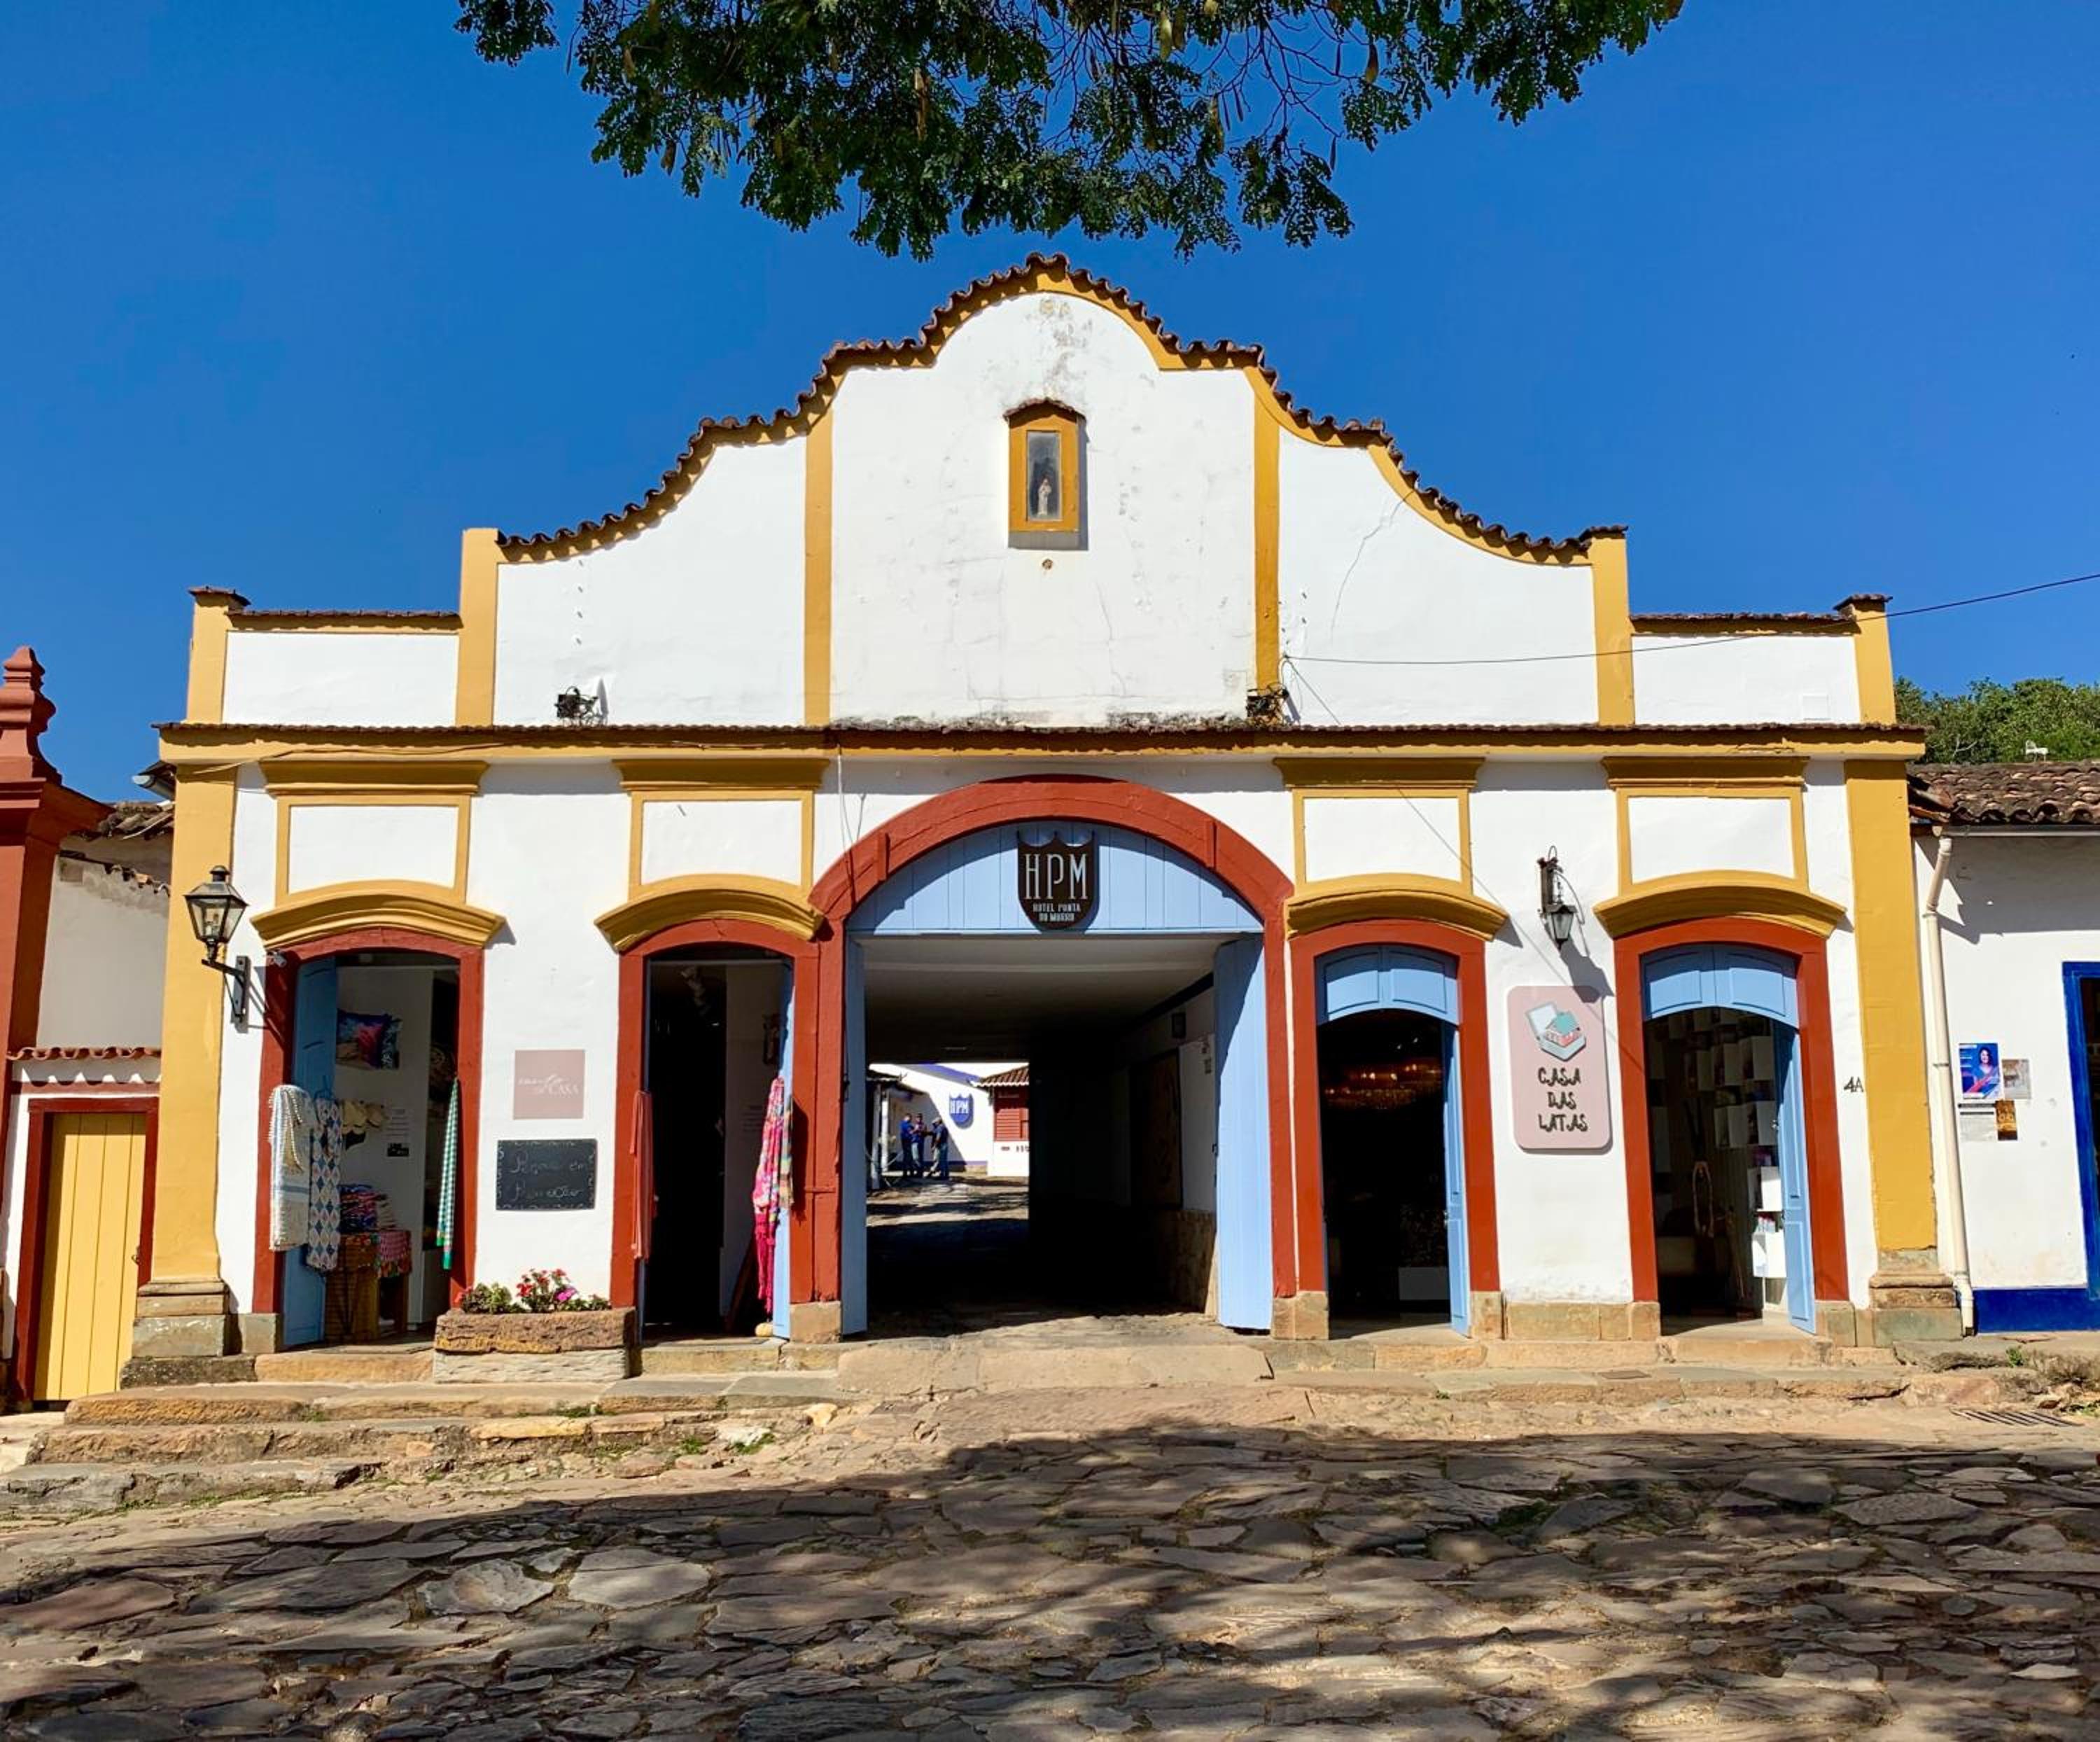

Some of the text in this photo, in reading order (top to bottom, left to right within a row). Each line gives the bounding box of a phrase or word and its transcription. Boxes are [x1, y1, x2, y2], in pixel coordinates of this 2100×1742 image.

[1024, 853, 1088, 900] HPM
[1032, 903, 1054, 912] HOTEL
[1538, 1067, 1581, 1086] CASA
[1843, 1076, 1863, 1093] 4A
[1547, 1092, 1576, 1109] DAS
[1538, 1113, 1588, 1132] LATAS
